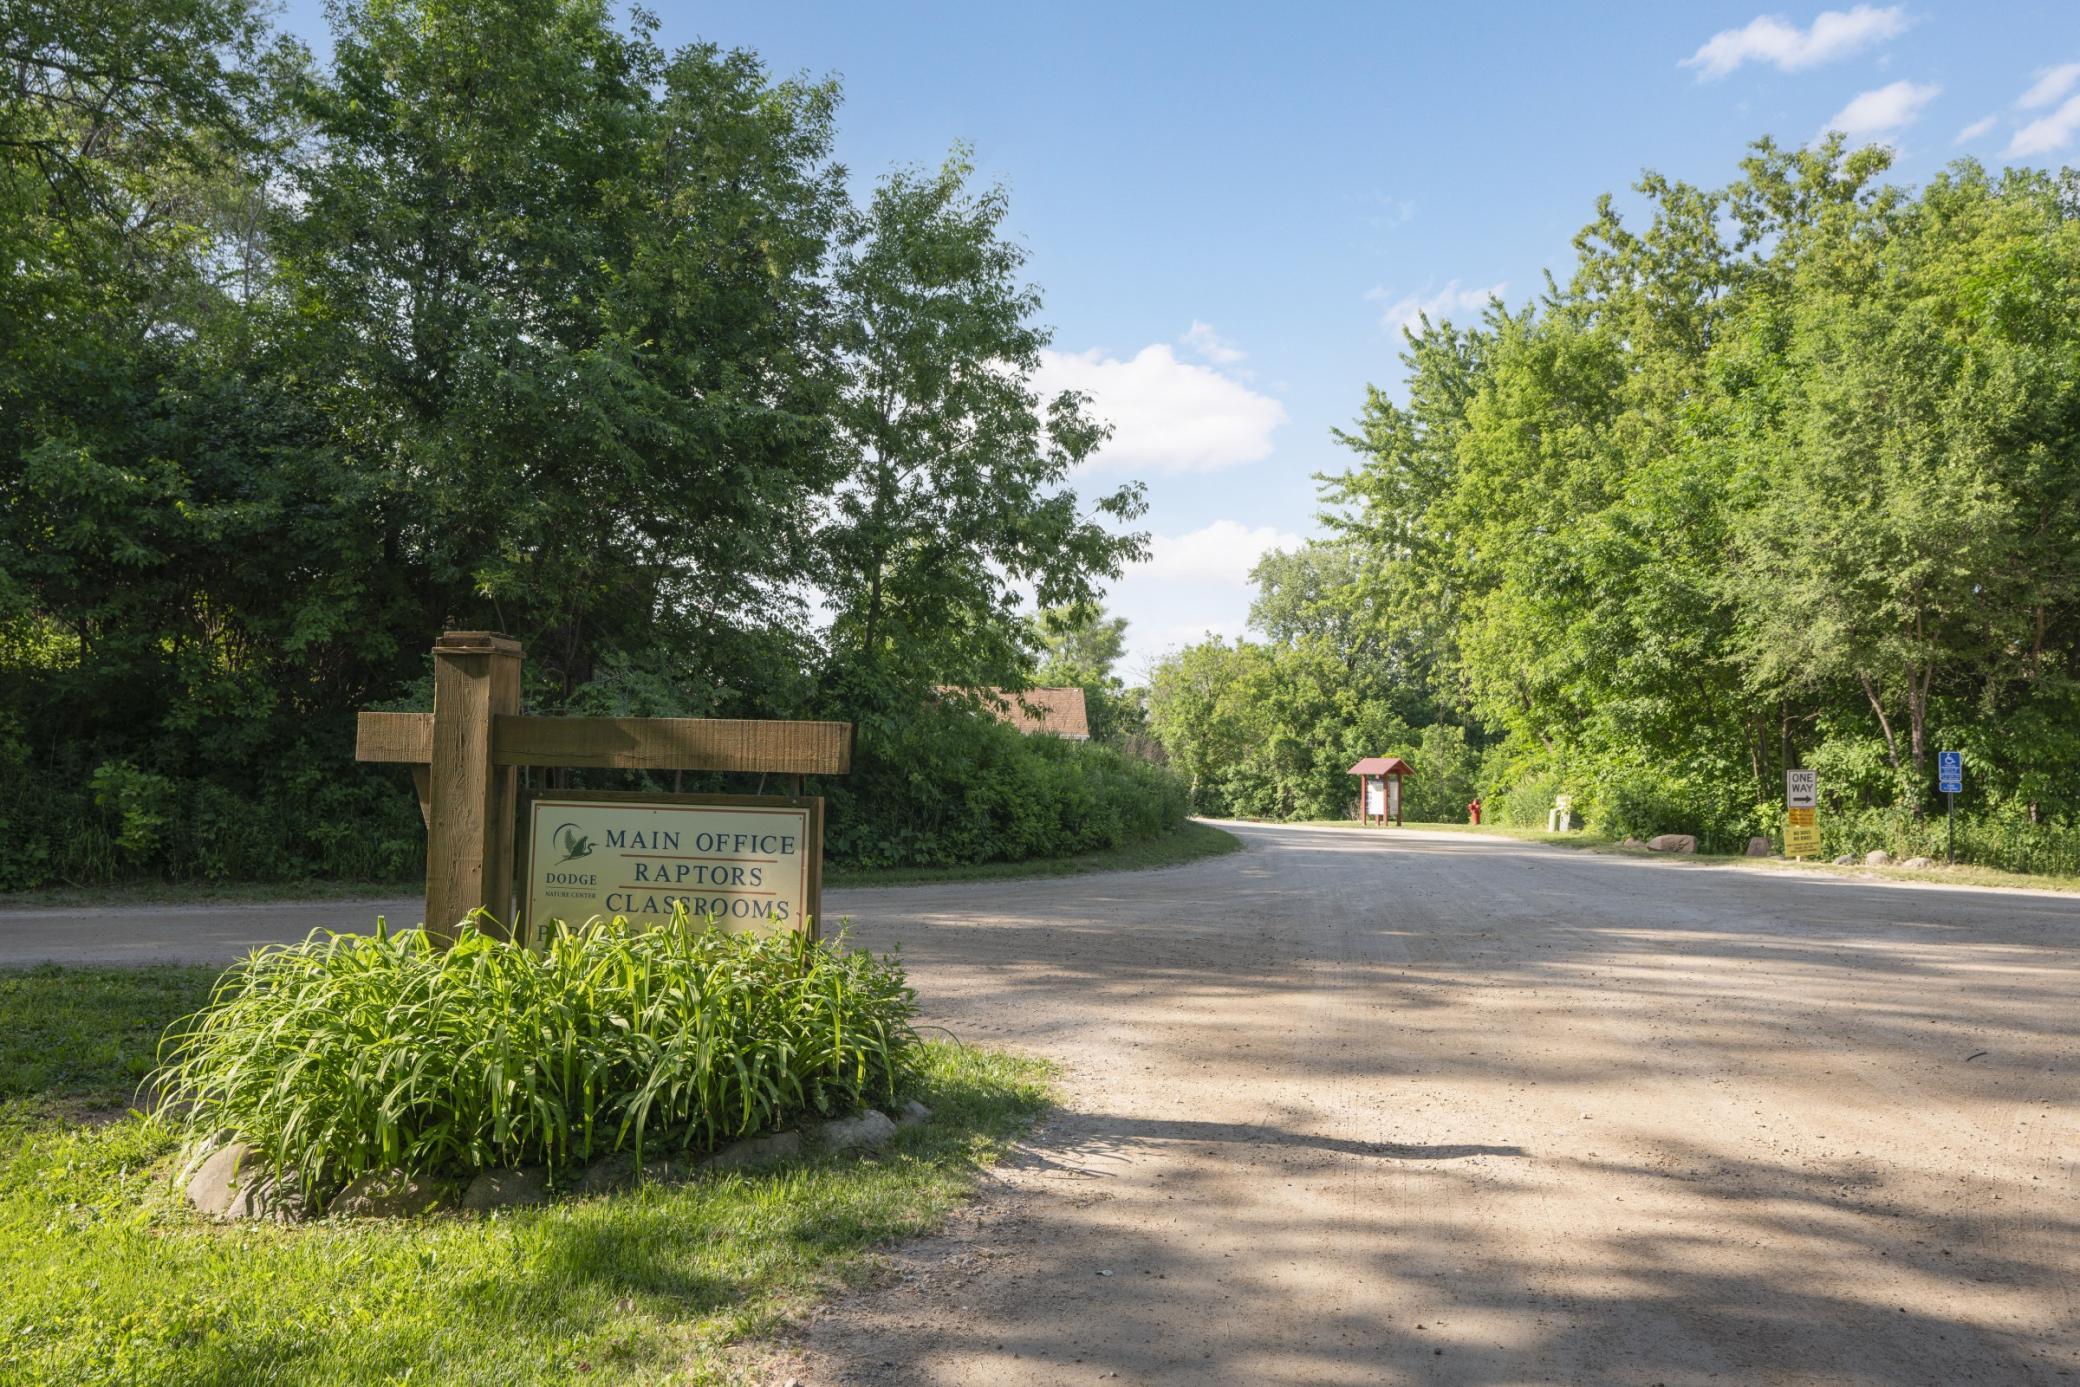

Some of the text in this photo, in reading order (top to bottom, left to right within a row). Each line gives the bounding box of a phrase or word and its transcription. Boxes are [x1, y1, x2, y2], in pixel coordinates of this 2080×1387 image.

[1792, 773, 1813, 782] ONE
[1792, 783, 1813, 792] WAY
[606, 829, 795, 855] MAIN OFFICE
[545, 872, 597, 886] DODGE
[633, 863, 762, 887] RAPTORS
[545, 889, 596, 899] NATURE CENTER
[606, 893, 789, 920] CLASSROOMS
